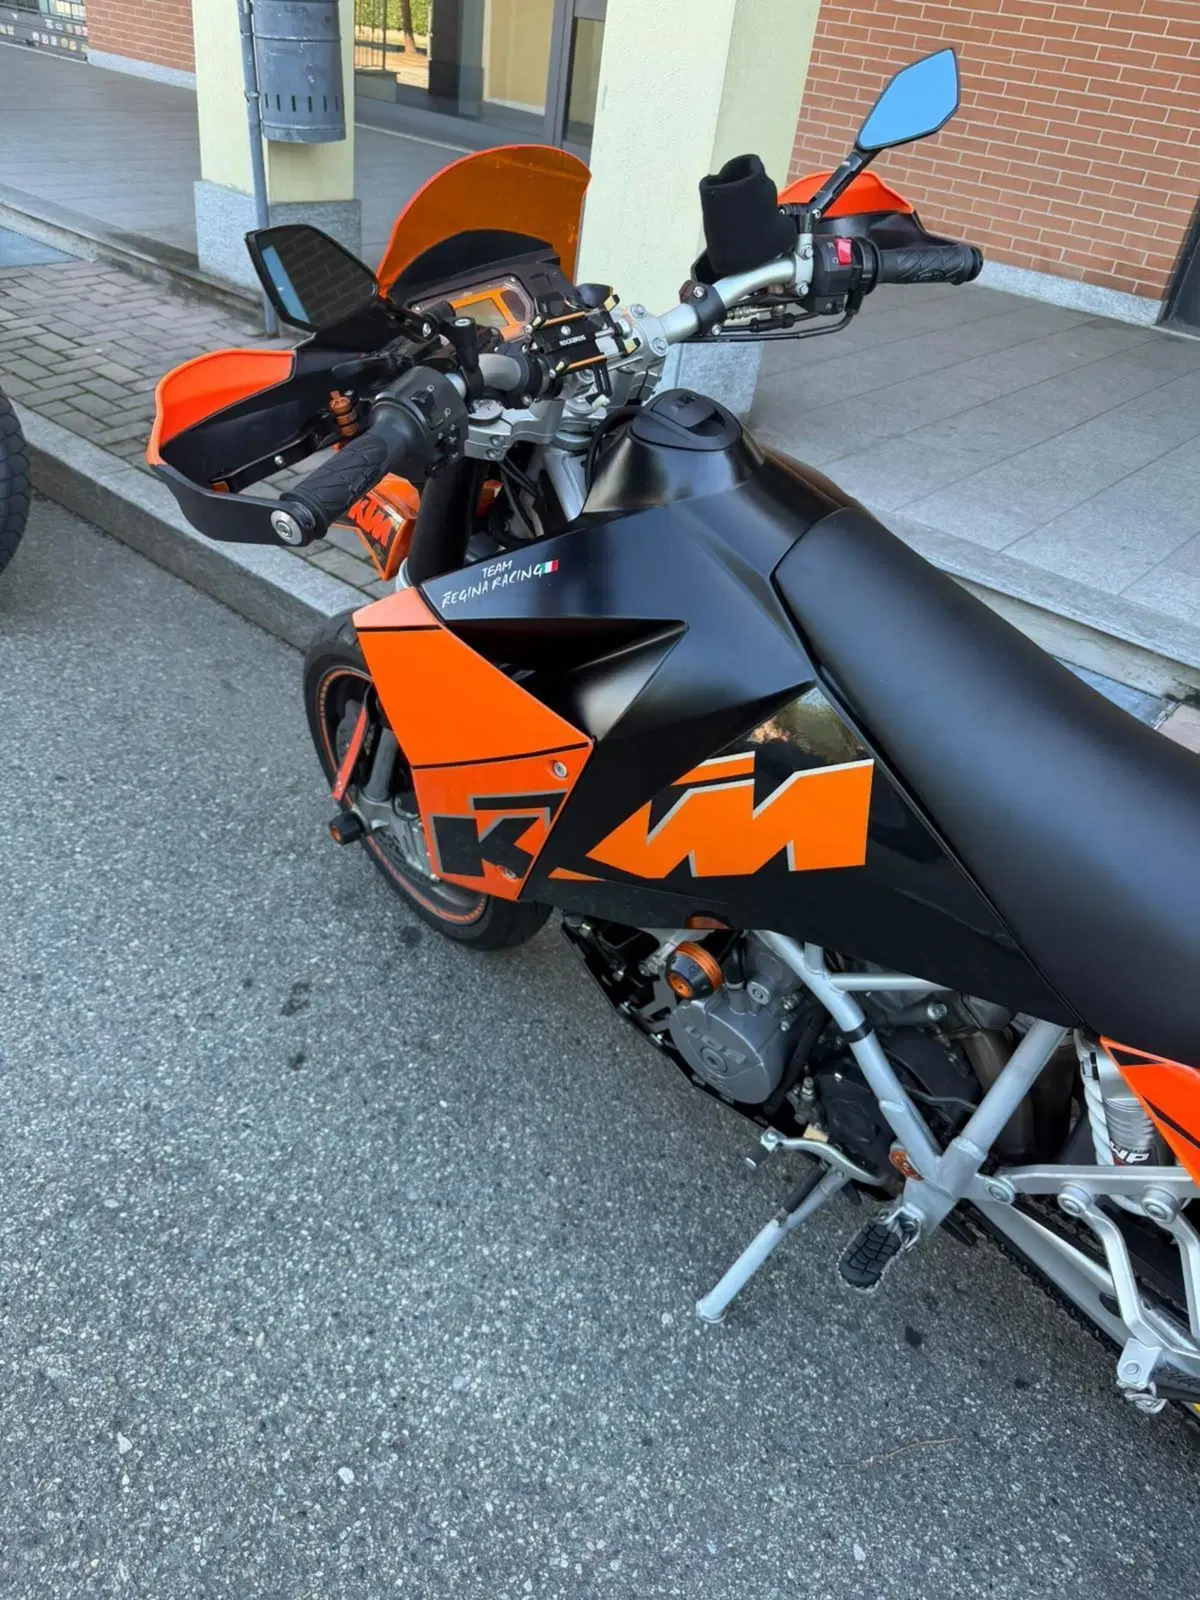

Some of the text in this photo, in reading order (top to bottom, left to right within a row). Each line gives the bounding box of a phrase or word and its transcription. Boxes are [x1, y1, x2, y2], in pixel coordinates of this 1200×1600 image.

[347, 499, 394, 548] KTM
[442, 563, 544, 608] REGINA RACING
[482, 560, 513, 578] TEAM
[430, 750, 874, 882] KTM
